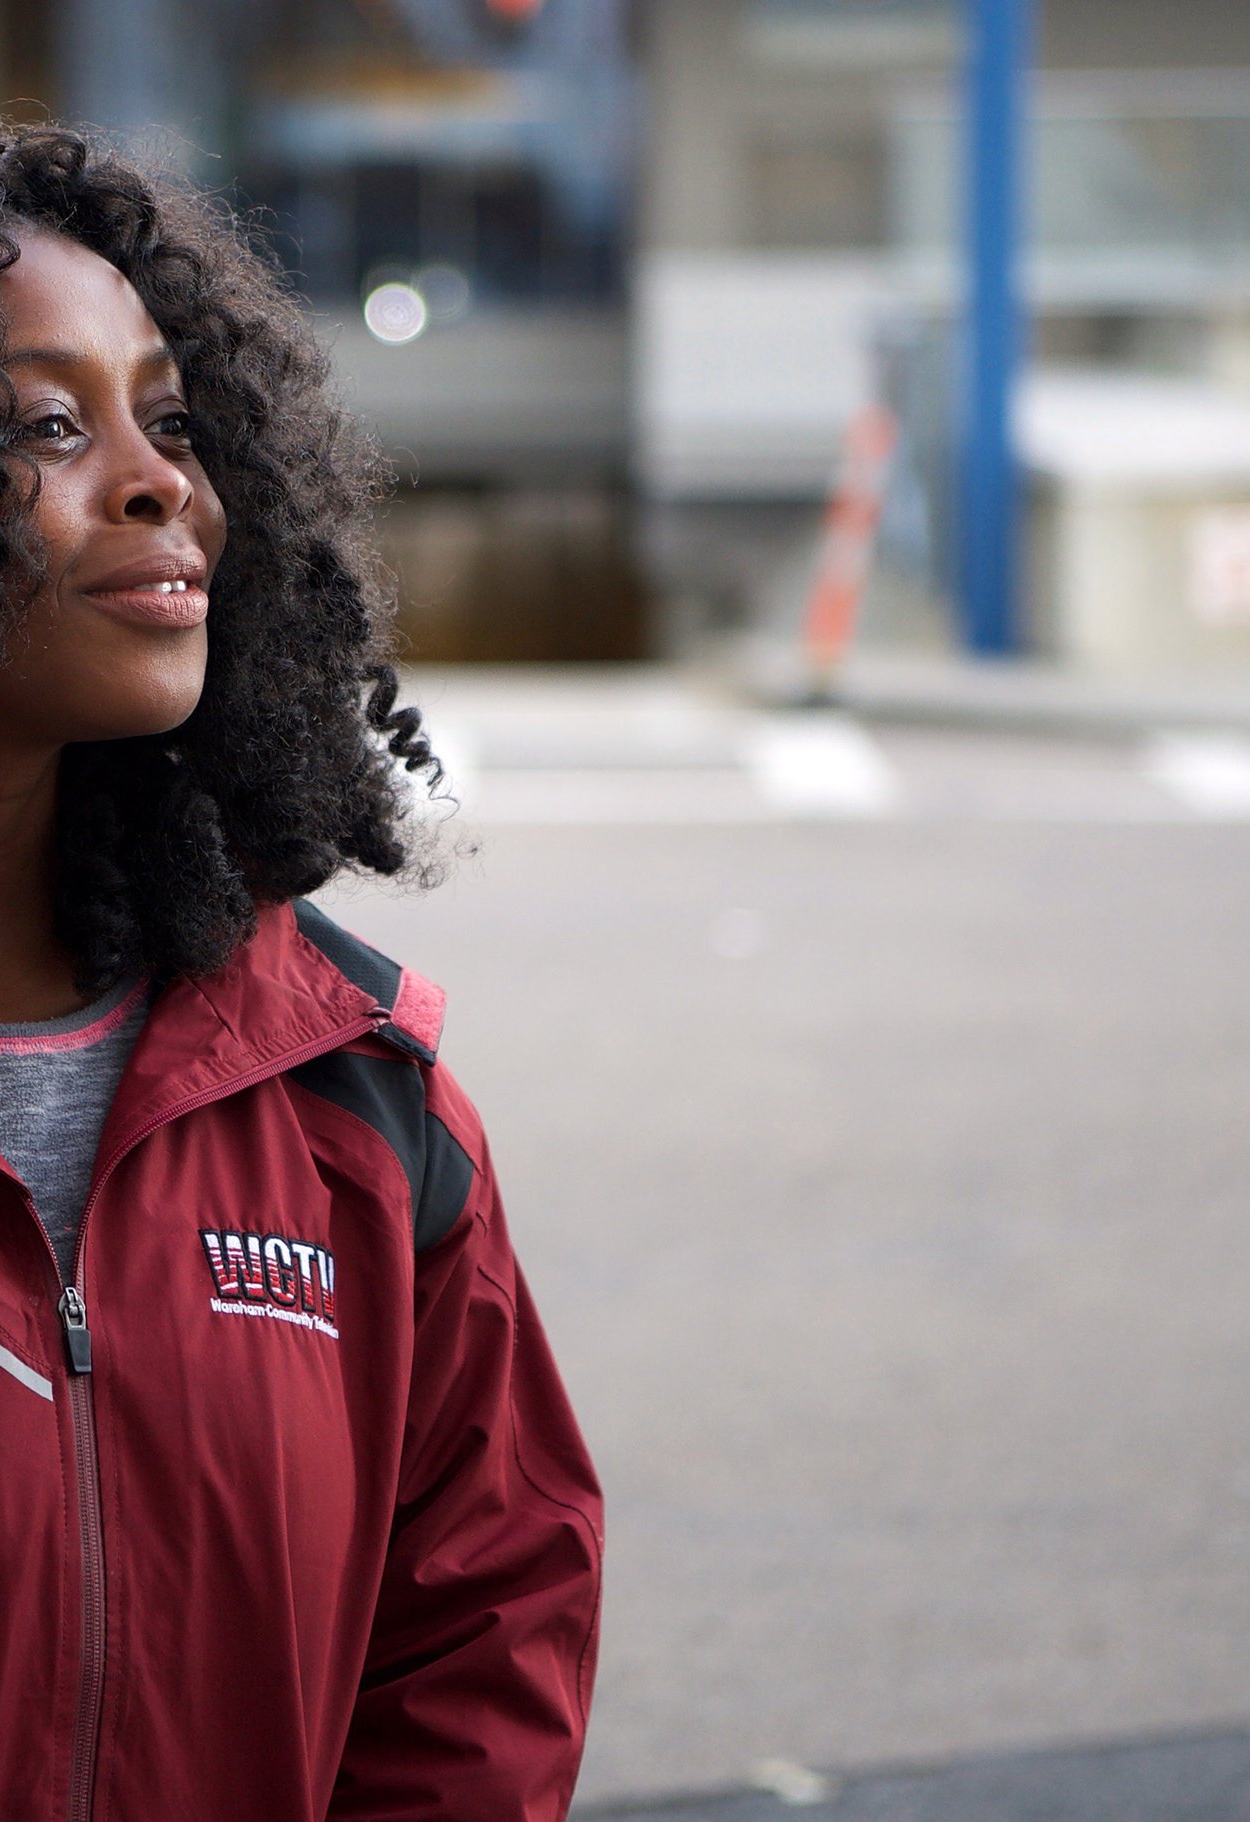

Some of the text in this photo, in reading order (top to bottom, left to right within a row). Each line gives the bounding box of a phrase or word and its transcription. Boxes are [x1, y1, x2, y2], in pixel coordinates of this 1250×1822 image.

[199, 1229, 335, 1322] WCTV
[210, 1298, 265, 1316] Wareham
[266, 1303, 313, 1330] Community
